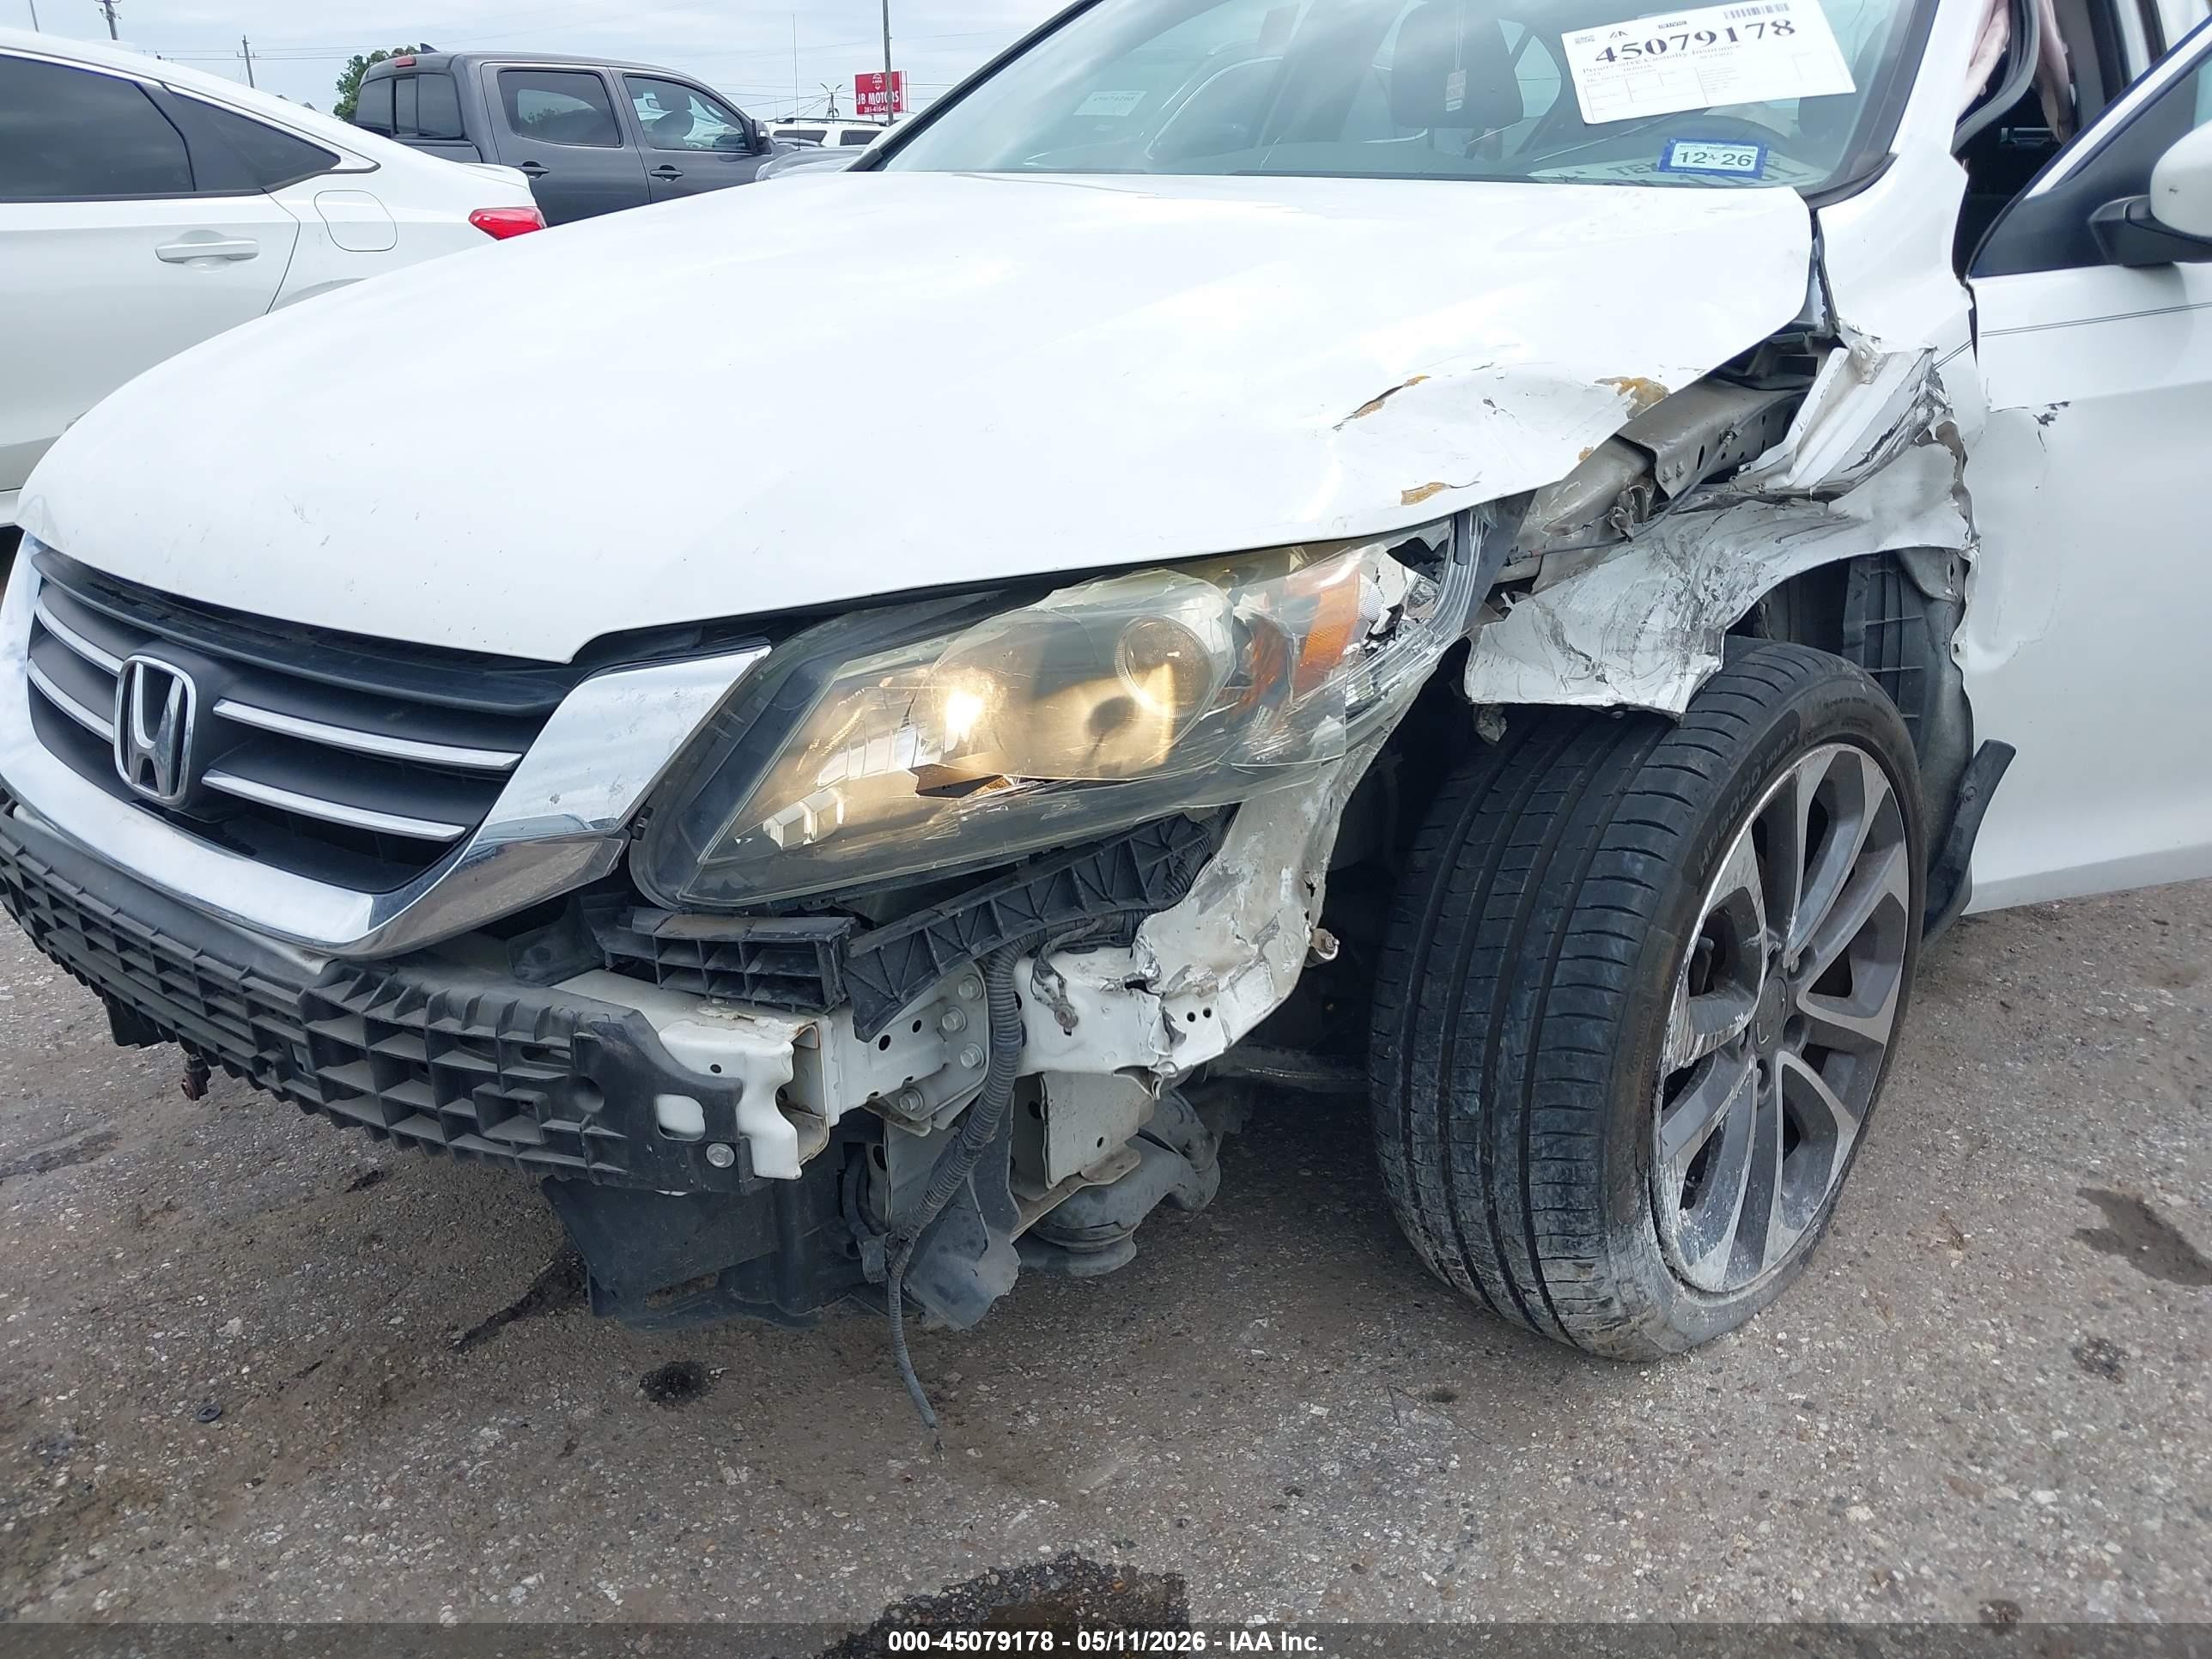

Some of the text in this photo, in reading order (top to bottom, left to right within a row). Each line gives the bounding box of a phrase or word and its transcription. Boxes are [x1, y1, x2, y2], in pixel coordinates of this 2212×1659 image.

[1595, 19, 1796, 63] 45079178
[857, 92, 866, 106] JB
[1679, 151, 1753, 167] 12 26
